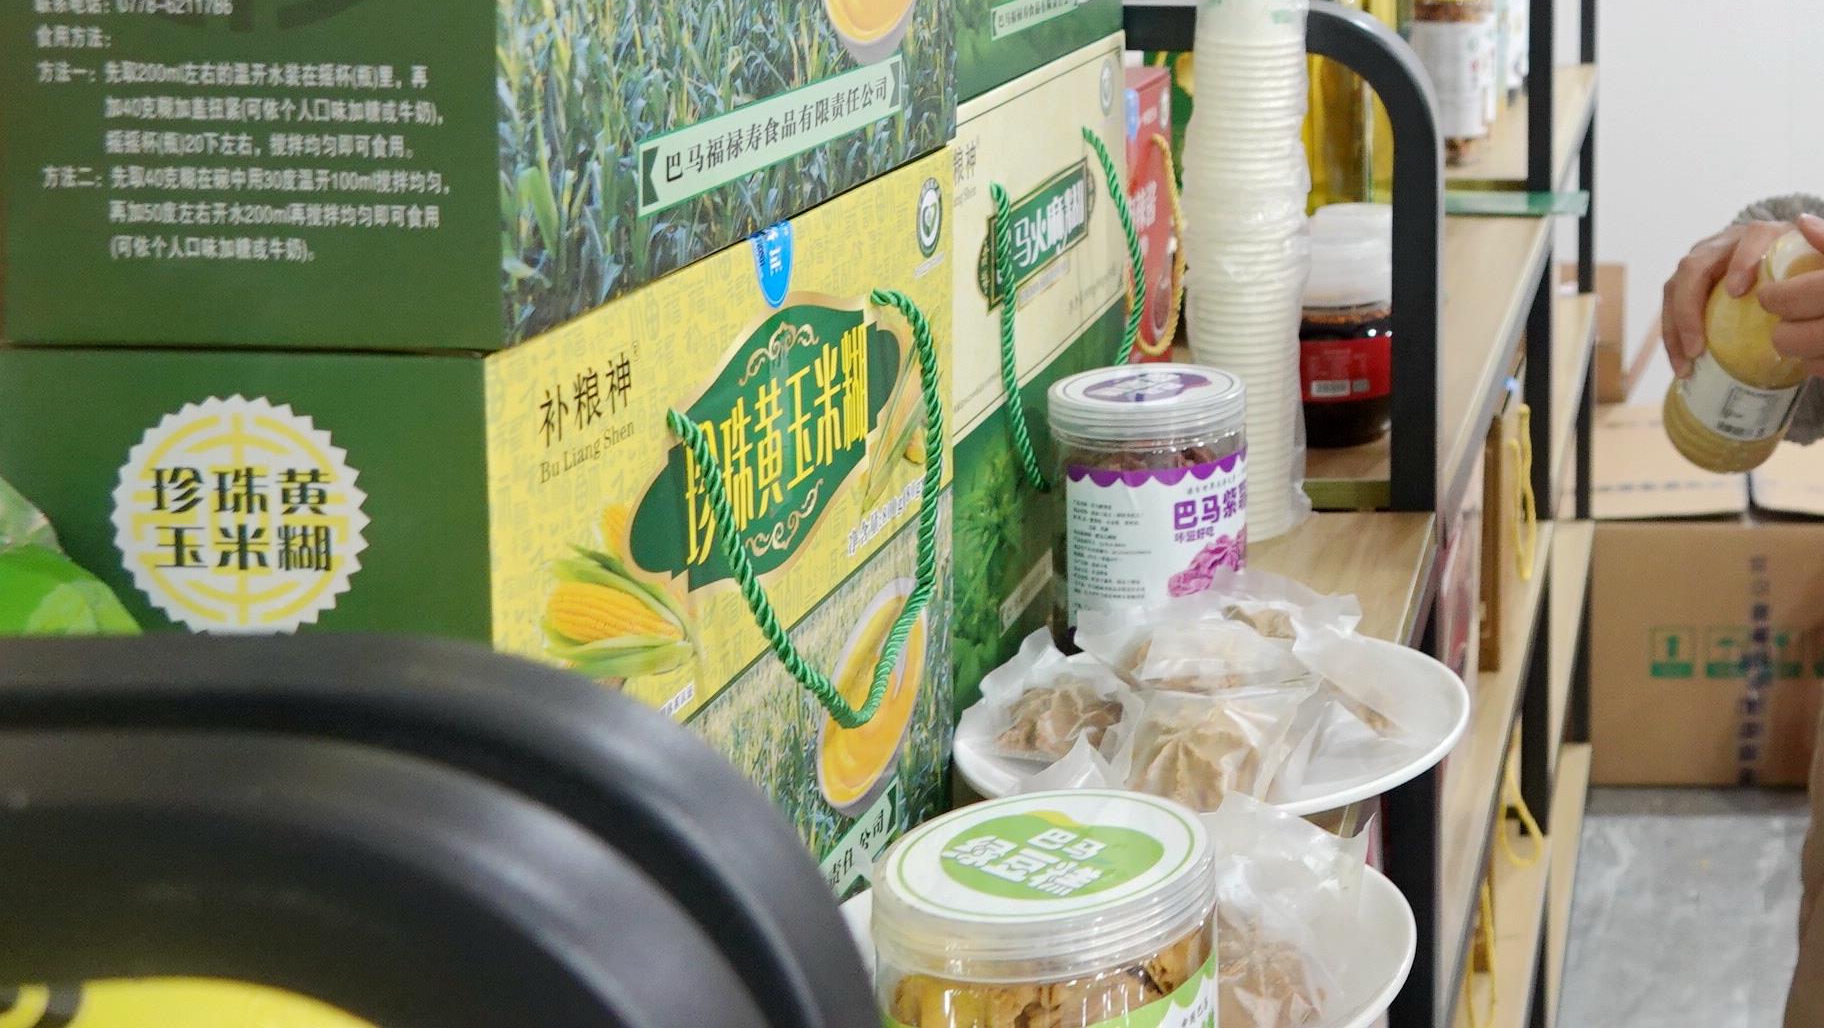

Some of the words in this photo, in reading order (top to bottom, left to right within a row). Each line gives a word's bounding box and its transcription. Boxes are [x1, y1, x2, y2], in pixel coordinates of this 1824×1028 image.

[665, 75, 888, 183] 巴马福禄寿食品有限责任公司
[998, 180, 1083, 282] 马火麻糊
[538, 352, 632, 449] 补粮神
[540, 461, 560, 484] Bu
[563, 439, 601, 472] Liang
[603, 421, 635, 451] Shen
[683, 323, 868, 564] 珍珠黄玉米糊
[150, 467, 332, 515] 珍珠黄
[155, 523, 333, 572] 玉米糊
[1026, 827, 1107, 862] 巴马
